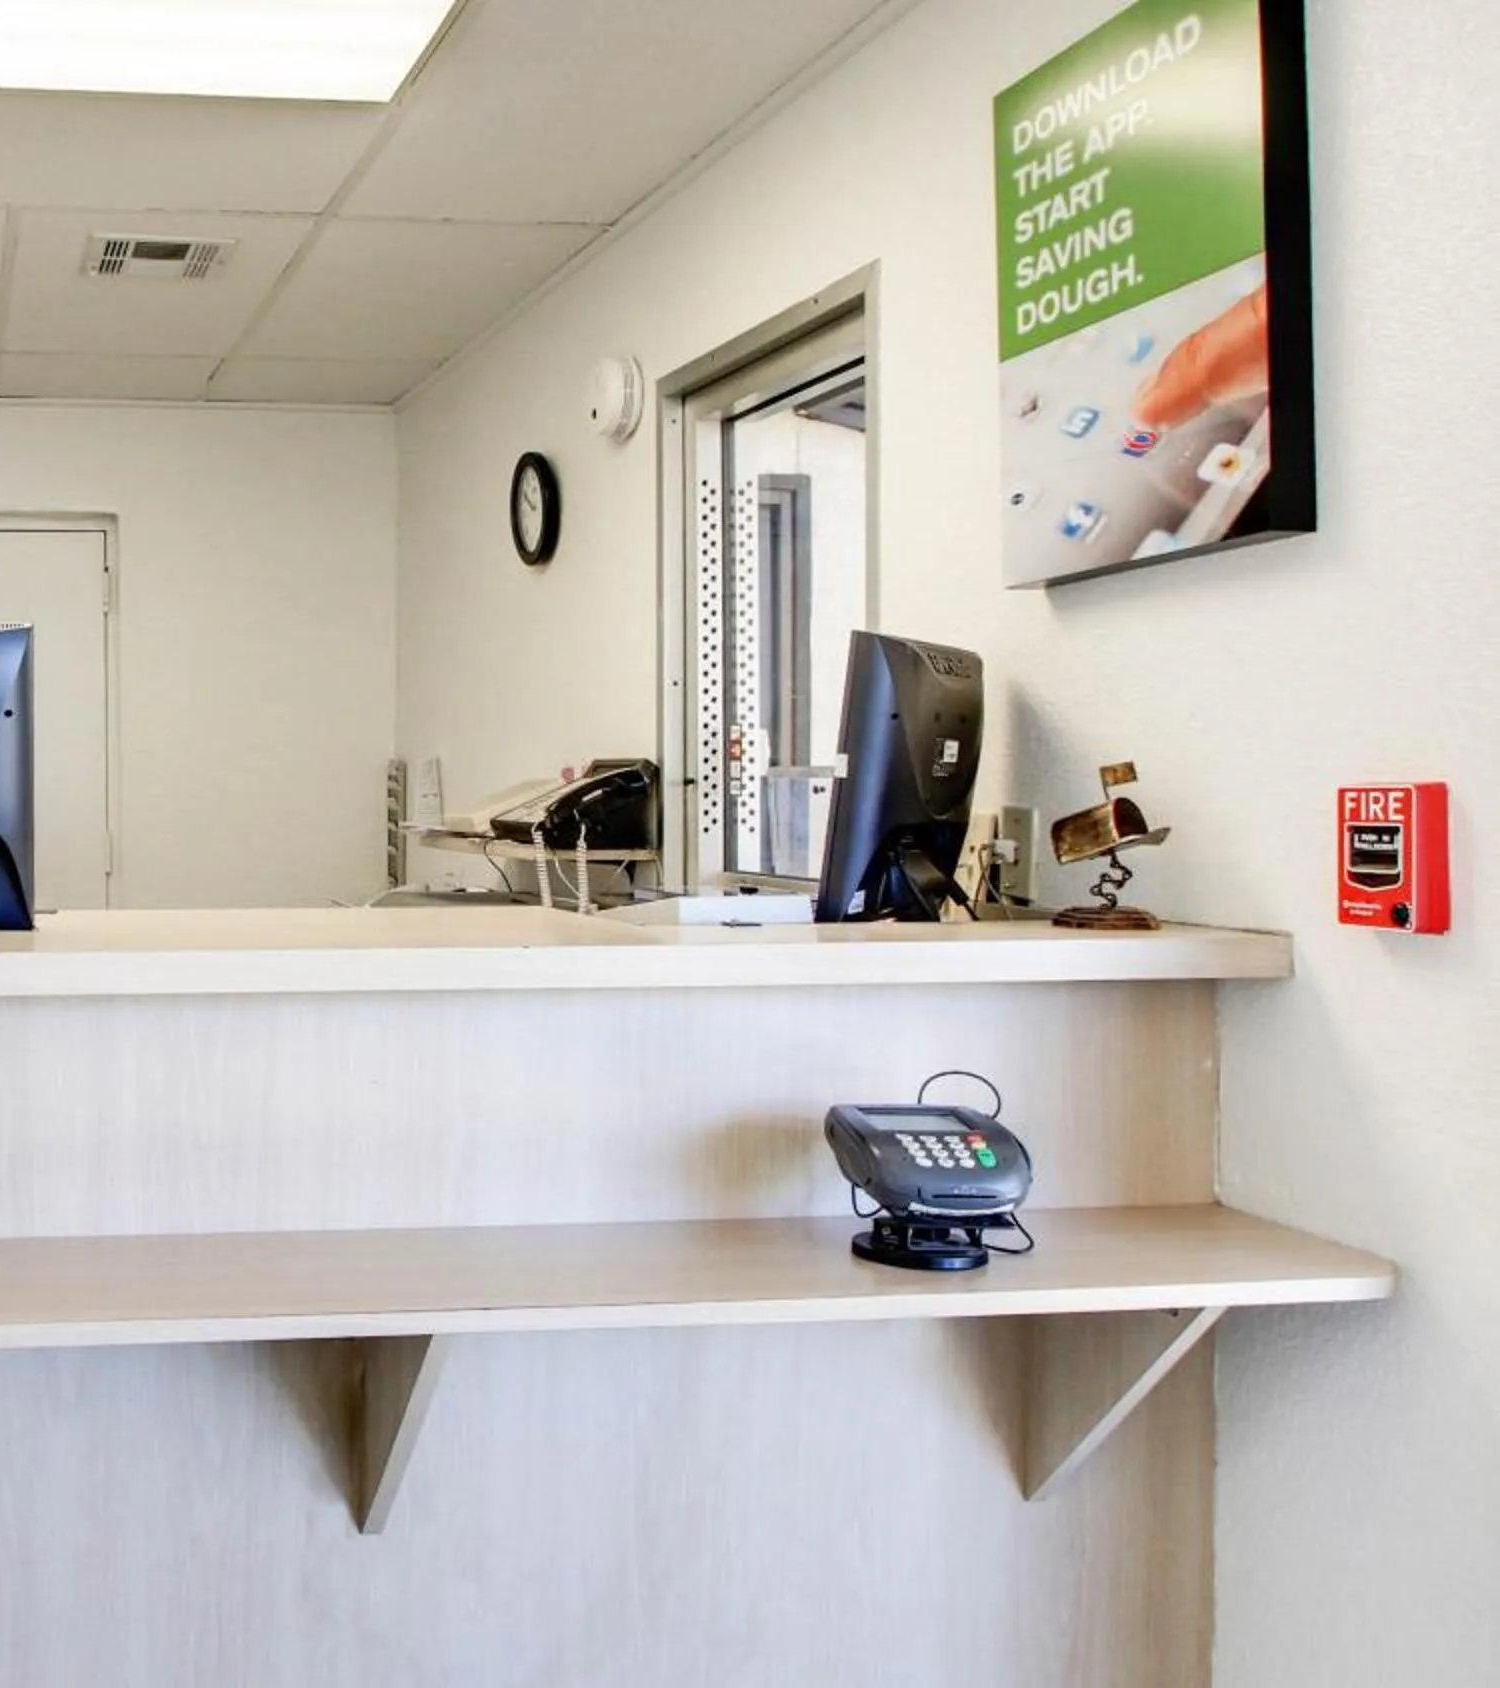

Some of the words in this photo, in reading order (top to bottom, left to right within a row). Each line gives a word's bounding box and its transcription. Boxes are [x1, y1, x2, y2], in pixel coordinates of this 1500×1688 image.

[1012, 14, 1201, 155] DOWNLOAD
[1013, 140, 1075, 198] THE
[1082, 98, 1155, 165] APP.
[1014, 167, 1111, 244] START
[1015, 207, 1134, 289] SAVING
[1016, 253, 1144, 335] DOUGH.
[1344, 790, 1405, 821] FIRE
